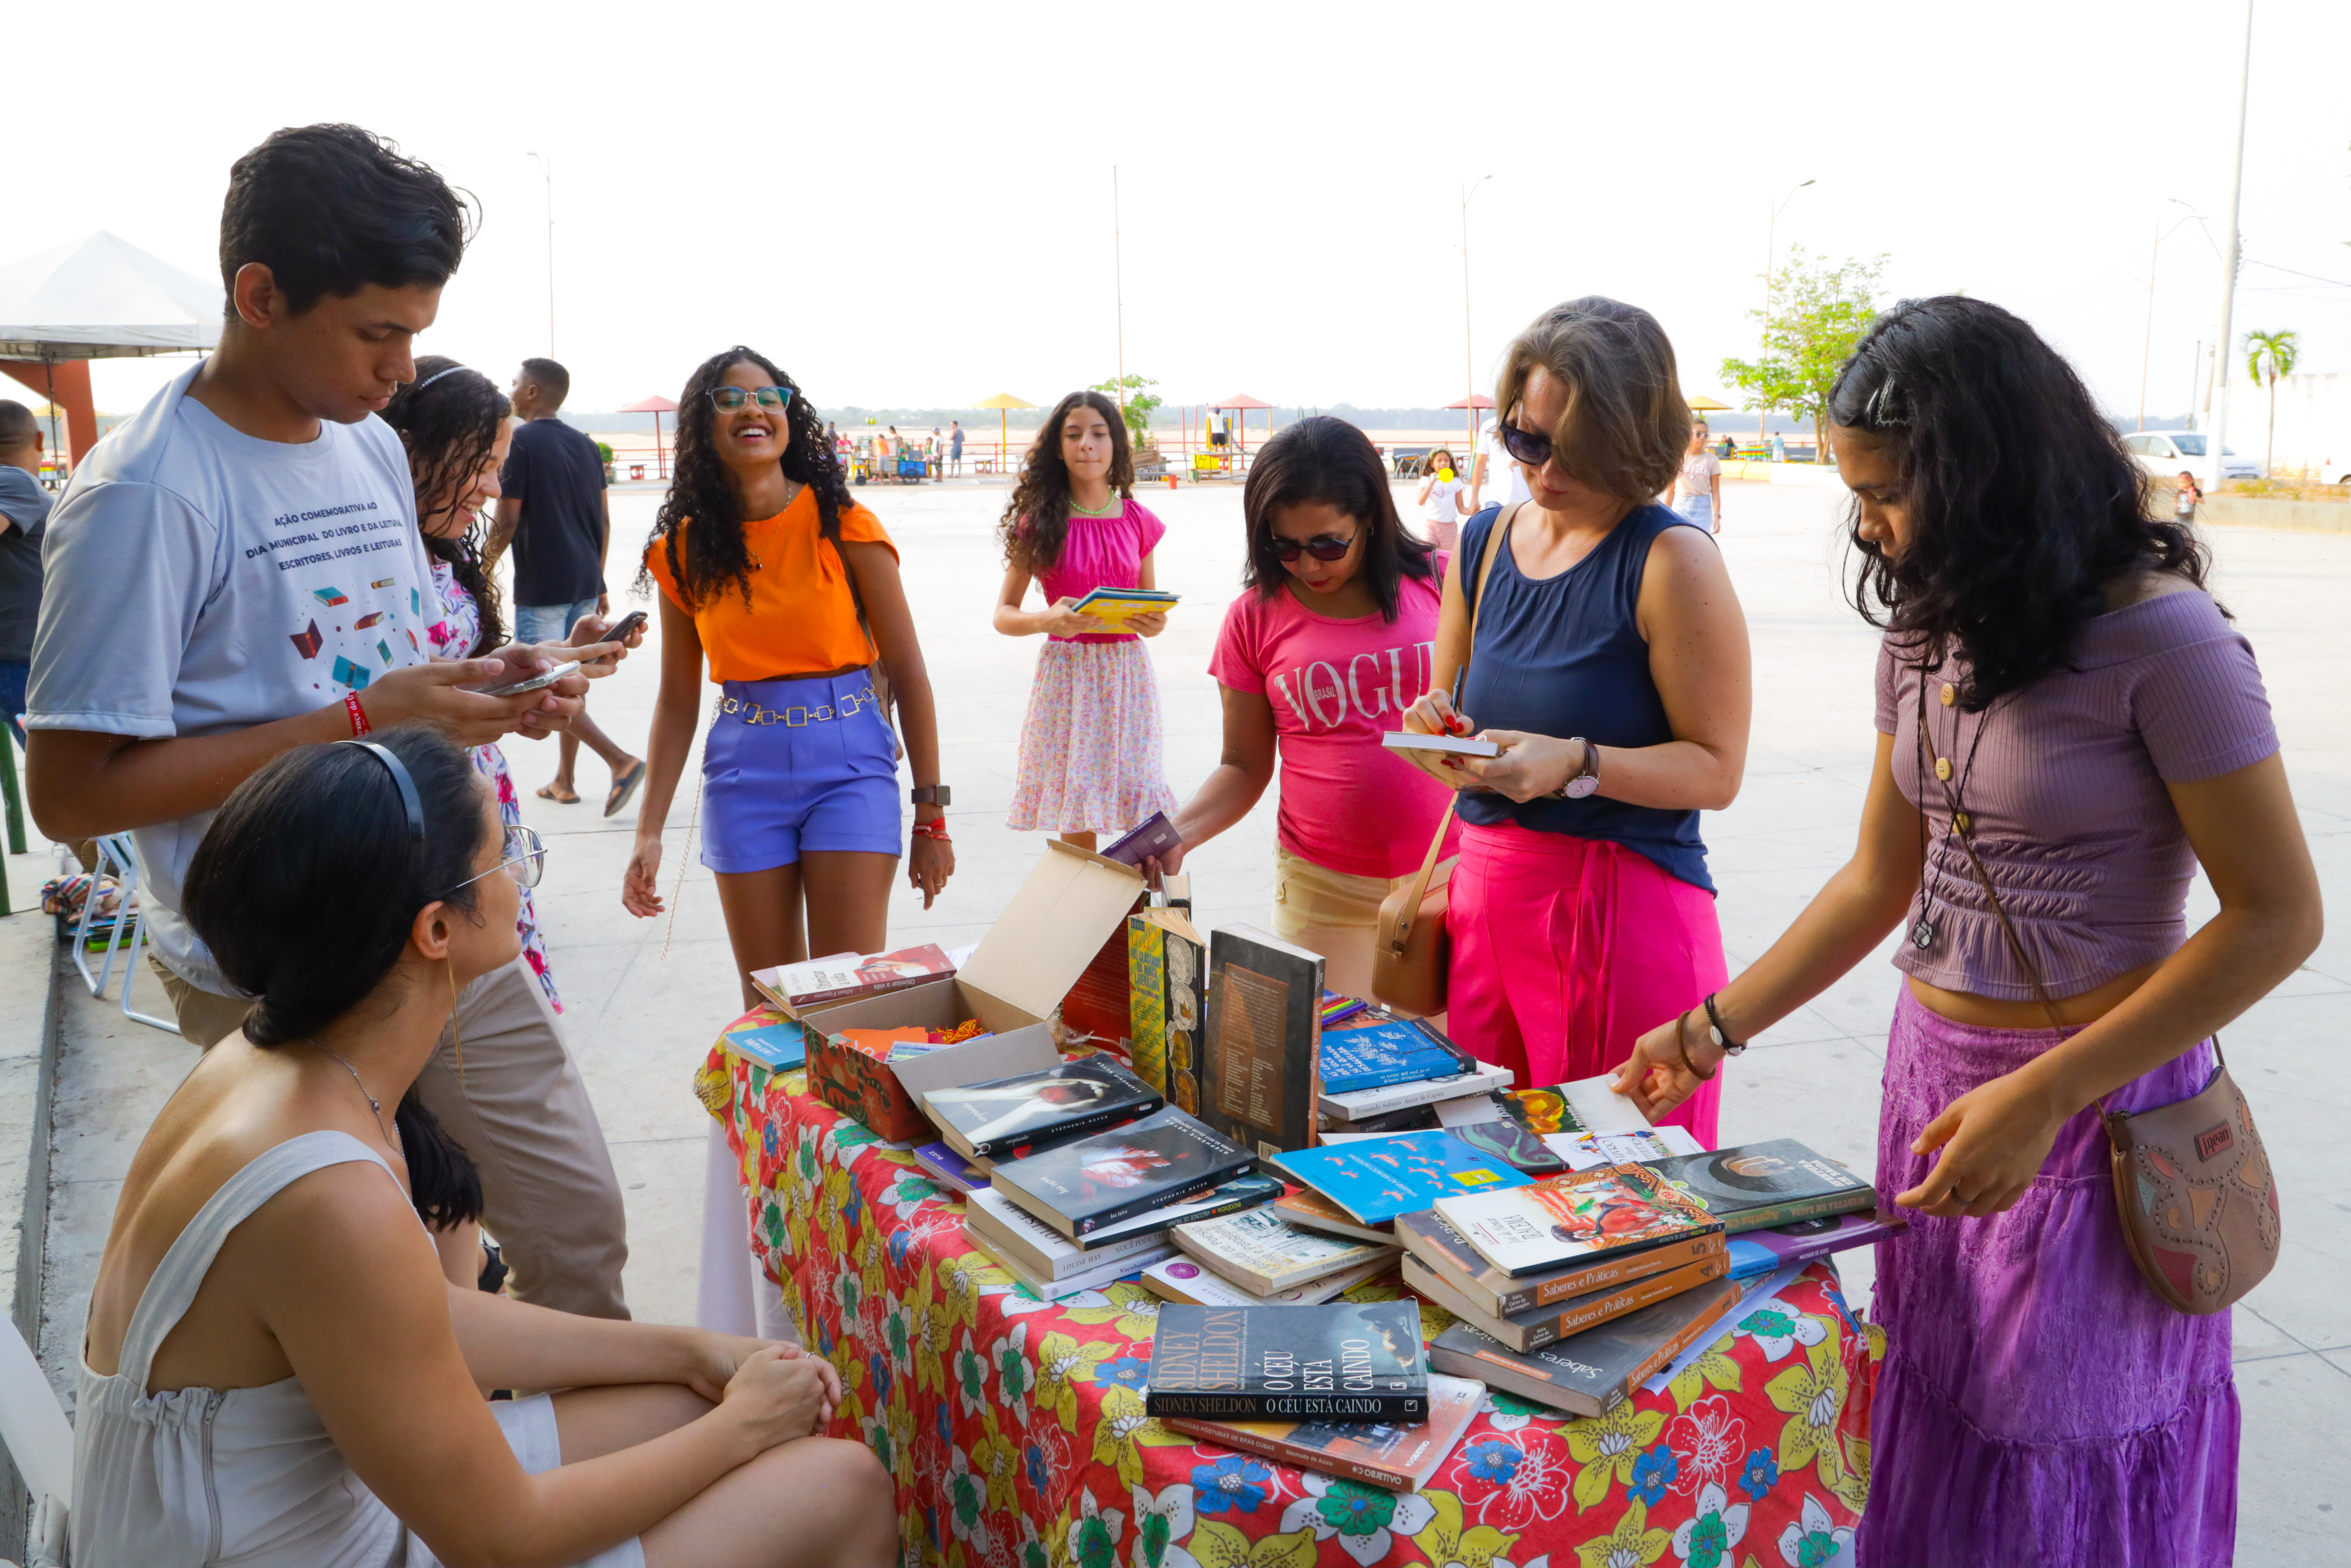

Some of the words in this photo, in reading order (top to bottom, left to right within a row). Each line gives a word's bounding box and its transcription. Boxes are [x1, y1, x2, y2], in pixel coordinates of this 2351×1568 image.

[274, 514, 299, 528] AÇÃO
[301, 503, 367, 522] COMEMORATIVA
[367, 502, 377, 511] AO
[245, 545, 268, 559] DIA
[269, 532, 319, 550] MUNICIPAL
[322, 528, 334, 539] DO
[336, 525, 359, 536] LIVRO
[361, 523, 367, 531] E
[368, 522, 379, 531] DA
[278, 552, 334, 571] ESCRITORES,
[335, 545, 362, 558] LIVROS
[370, 539, 402, 550] LEITURAS
[891, 979, 915, 990] Otimizar
[1326, 1046, 1347, 1065] QUANDO
[1337, 1046, 1372, 1072] DESACELERA
[1097, 1062, 1114, 1074] MEYER
[1114, 1074, 1141, 1093] STEPHENIE
[1356, 1105, 1381, 1114] Fernando
[1383, 1100, 1401, 1108] Sabino
[1404, 1096, 1419, 1105] Amor
[1427, 1091, 1444, 1100] Capitu
[1006, 1135, 1029, 1146] crepúsculo
[1051, 1121, 1085, 1133] STEPHENIE
[1165, 1119, 1188, 1133] MEYER
[1370, 1122, 1385, 1131] CORTIÇO
[1189, 1133, 1229, 1155] STEPHENIE
[1603, 1141, 1624, 1158] LIVRO
[1624, 1147, 1636, 1156] das
[1040, 1176, 1058, 1187] nova
[1798, 1159, 1845, 1187] AVENTURA
[1839, 1176, 1857, 1185] EM
[1056, 1184, 1069, 1195] lua
[1152, 1190, 1186, 1204] STEPHENIE
[1188, 1181, 1208, 1192] MEYER
[1218, 1202, 1241, 1213] INOCÊNCIA
[1291, 1201, 1325, 1213] Assis
[1816, 1202, 1828, 1212] EM
[1828, 1197, 1866, 1209] AVENTURA
[1190, 1211, 1210, 1221] VISCONDE
[1741, 1210, 1779, 1226] Agatha
[1501, 1215, 1544, 1239] IRACEMA
[1063, 1259, 1086, 1271] LOUISE
[1088, 1253, 1101, 1262] HAY
[1116, 1240, 1134, 1252] VOCÊ
[1135, 1236, 1152, 1246] PODE
[1153, 1232, 1165, 1242] TER
[1221, 1245, 1235, 1254] de
[1120, 1259, 1153, 1273] Vocabulário
[1232, 1252, 1267, 1269] Festival
[1543, 1283, 1576, 1297] Saberes
[1587, 1268, 1619, 1284] Práticas
[1692, 1242, 1706, 1255] 5
[1566, 1313, 1596, 1329] Saberes
[1605, 1296, 1634, 1313] Práticas
[1701, 1262, 1713, 1277] 4
[1506, 1302, 1530, 1313] Enfermagem
[1530, 1334, 1553, 1347] Enfermagem
[1156, 1328, 1199, 1389] SIDNEY
[1198, 1310, 1241, 1390] SHELDON
[1482, 1352, 1512, 1366] Enfermagem
[1255, 1351, 1293, 1376] CÉU
[1342, 1339, 1374, 1391] CAINDO
[1538, 1351, 1603, 1379] Saberes
[1632, 1362, 1653, 1386] Saberes
[1658, 1343, 1678, 1363] Práticas
[1264, 1377, 1293, 1390] O
[1293, 1359, 1333, 1391] ESTÁ
[1154, 1398, 1198, 1412] SIDNEY
[1199, 1398, 1256, 1413] SHELDON
[1266, 1399, 1276, 1413] O
[1278, 1395, 1302, 1413] CÉU
[1305, 1395, 1333, 1413] ESTÁ
[1336, 1399, 1381, 1413] CAINDO
[1172, 1418, 1199, 1430] MEMÓRIAS
[1201, 1426, 1229, 1439] PÓSTUMAS
[1240, 1436, 1254, 1445] BRÁS
[1256, 1441, 1275, 1451] CUBAS
[1286, 1449, 1310, 1460] Machado
[1318, 1458, 1333, 1466] Assis
[1410, 1441, 1430, 1461] OBJETIVO
[1364, 1469, 1401, 1484] OBJETIVO
